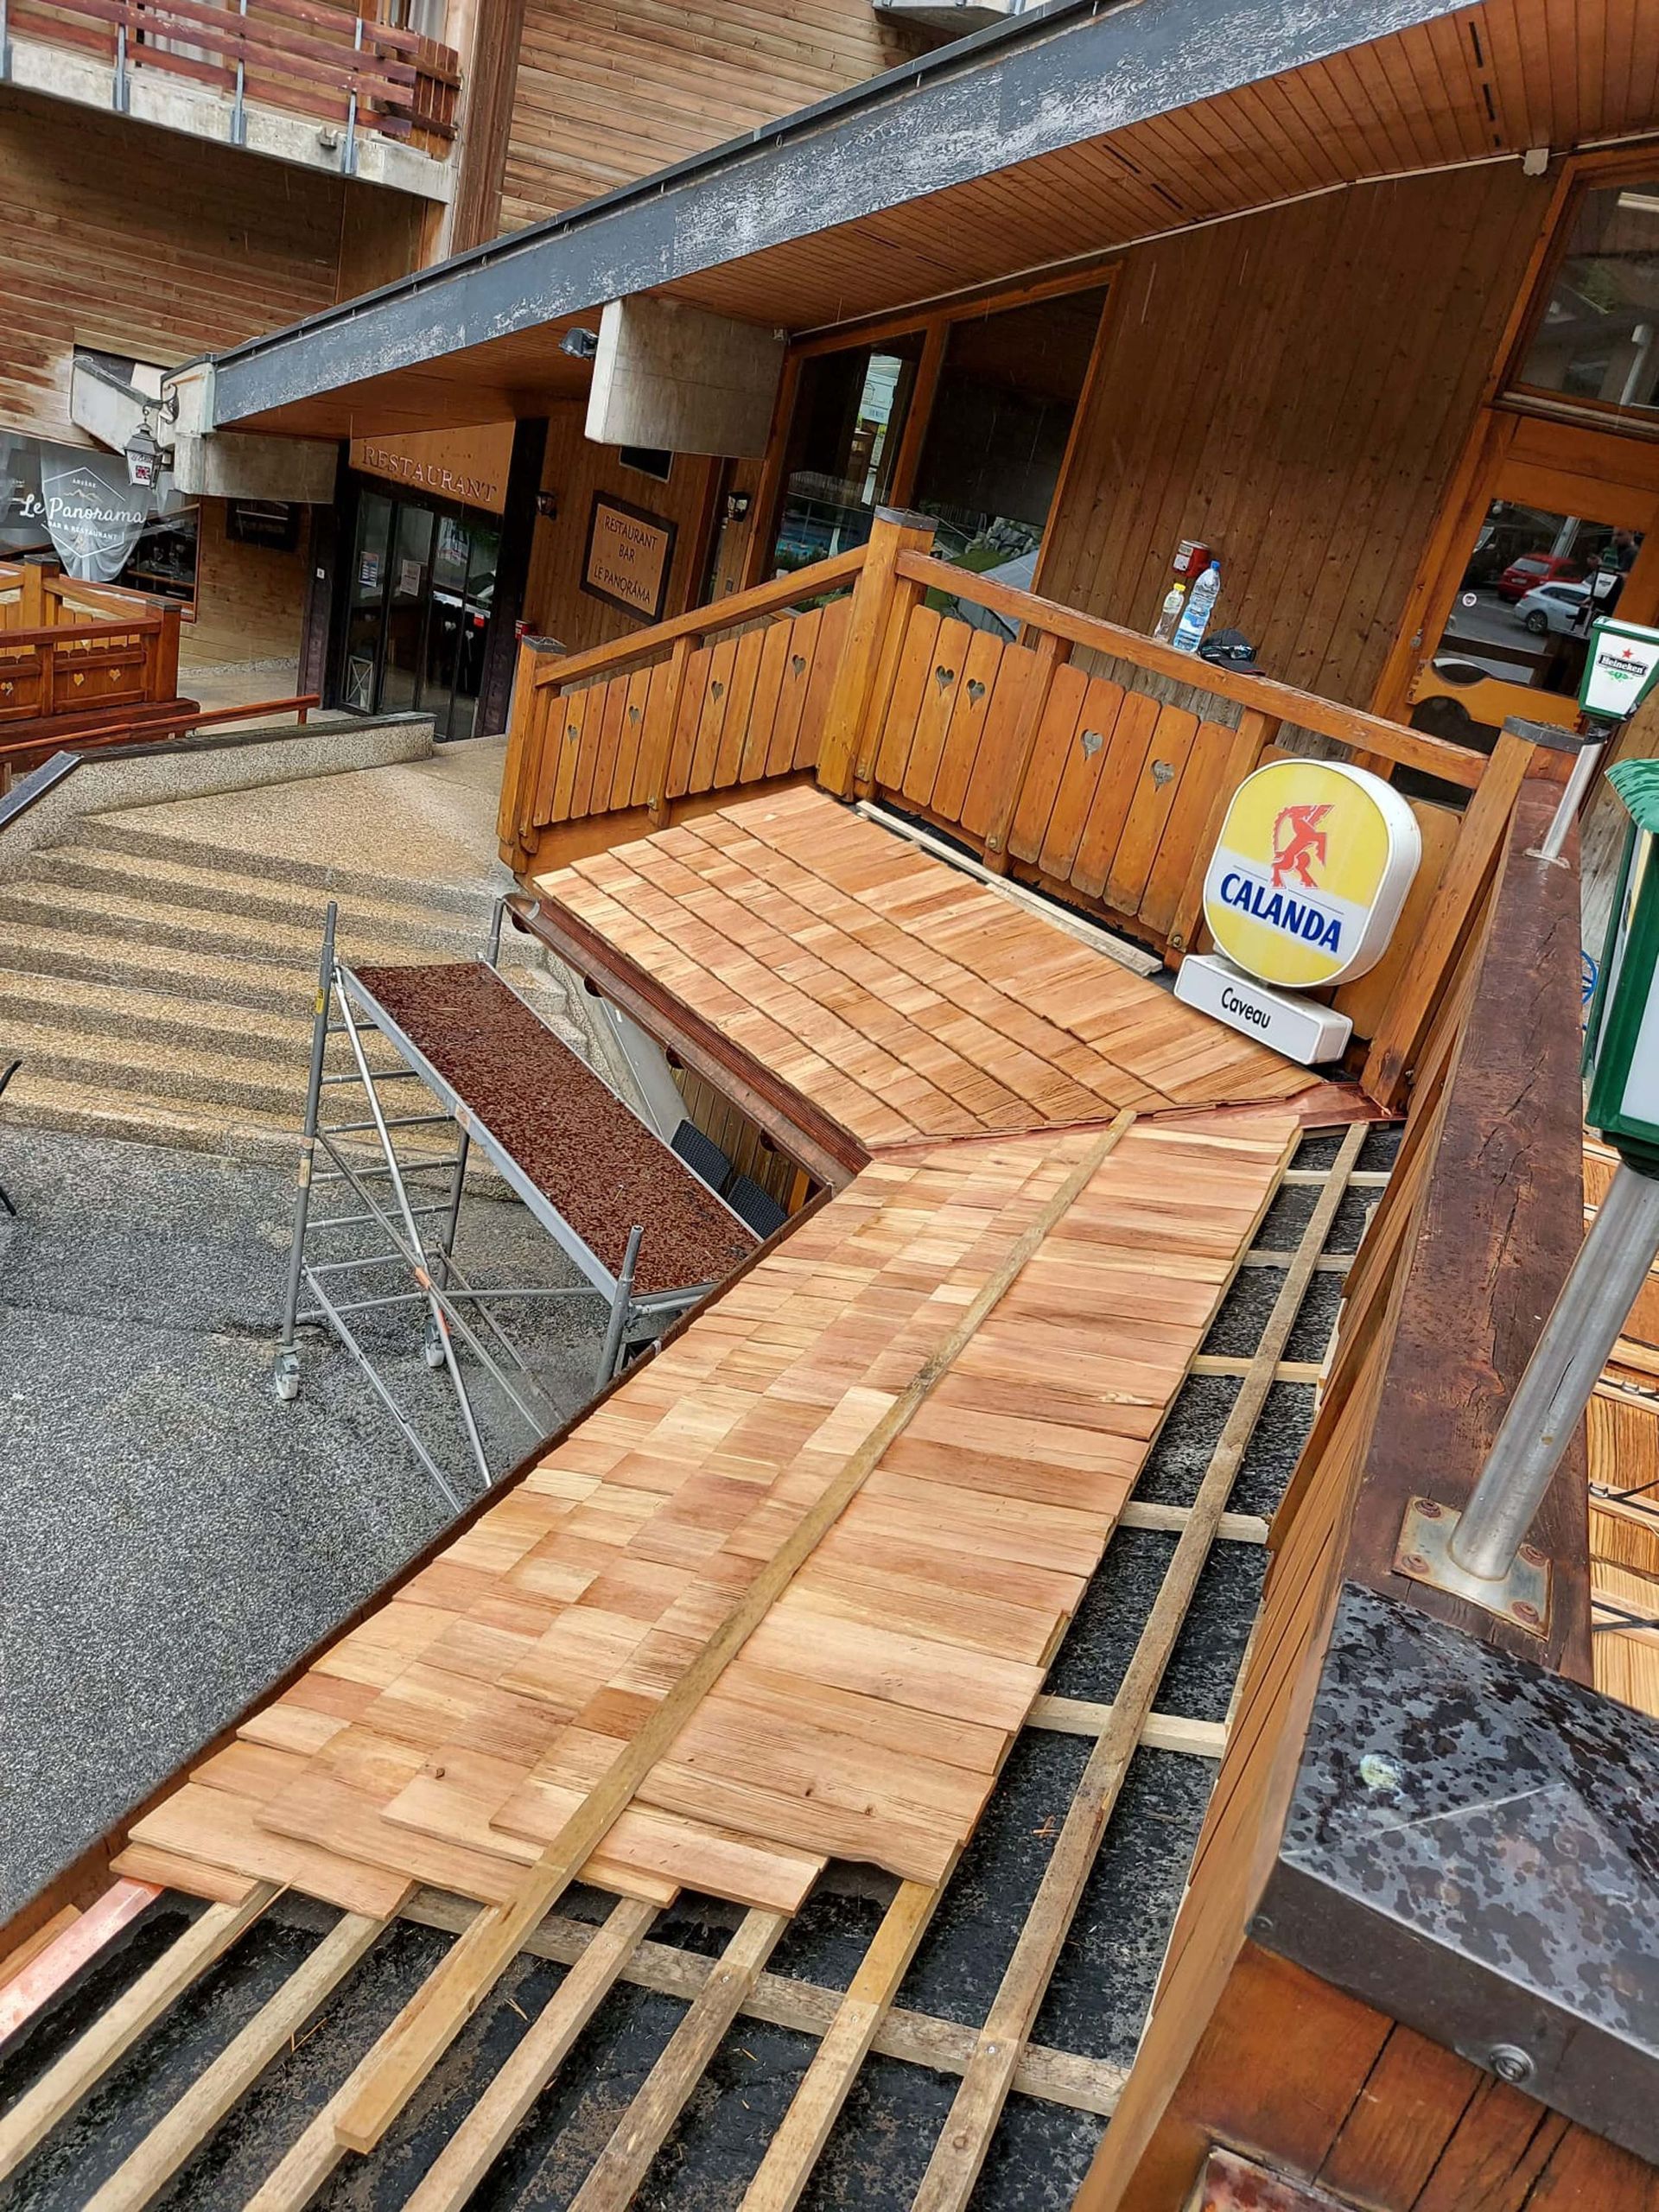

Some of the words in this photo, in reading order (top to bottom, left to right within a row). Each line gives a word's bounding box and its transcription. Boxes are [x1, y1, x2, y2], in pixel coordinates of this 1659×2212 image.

[362, 445, 497, 502] RESTAURANT
[19, 493, 45, 518] Le
[48, 497, 147, 524] Panorama
[48, 521, 63, 530] BAR
[71, 526, 118, 541] RESTAURANT
[605, 516, 658, 550] RESTAURANT
[619, 544, 635, 563] BAR
[594, 564, 603, 580] LE
[604, 569, 651, 603] PANORAMA
[1601, 657, 1643, 675] Heineken
[1220, 873, 1342, 953] CALANDA
[1221, 987, 1271, 1028] Caveau
